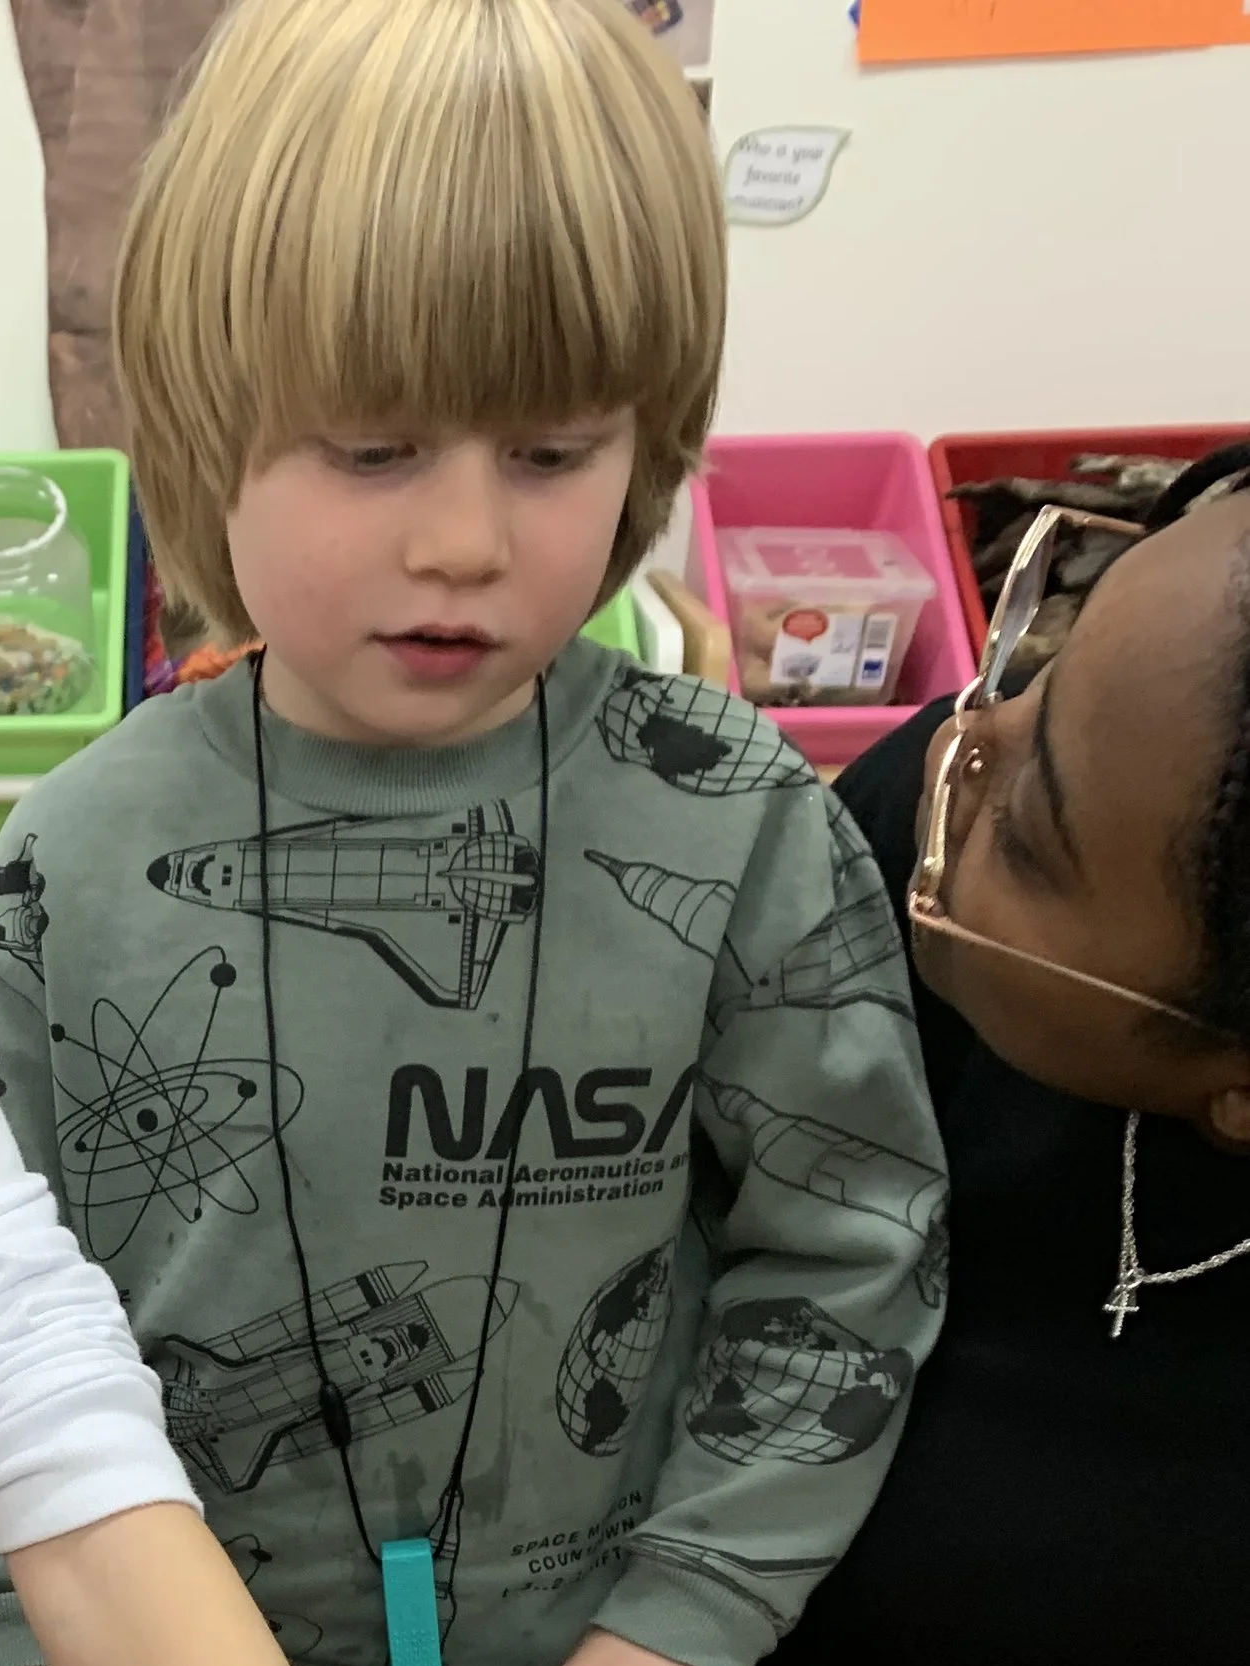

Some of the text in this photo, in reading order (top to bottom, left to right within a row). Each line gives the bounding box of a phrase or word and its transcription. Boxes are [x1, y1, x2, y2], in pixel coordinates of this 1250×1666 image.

[792, 146, 824, 164] your
[744, 163, 801, 187] favorite
[385, 1064, 696, 1161] NASA
[382, 1162, 504, 1185] National
[513, 1156, 665, 1184] Aeronautics
[379, 1186, 468, 1211] Space
[511, 1531, 581, 1556] SPACE
